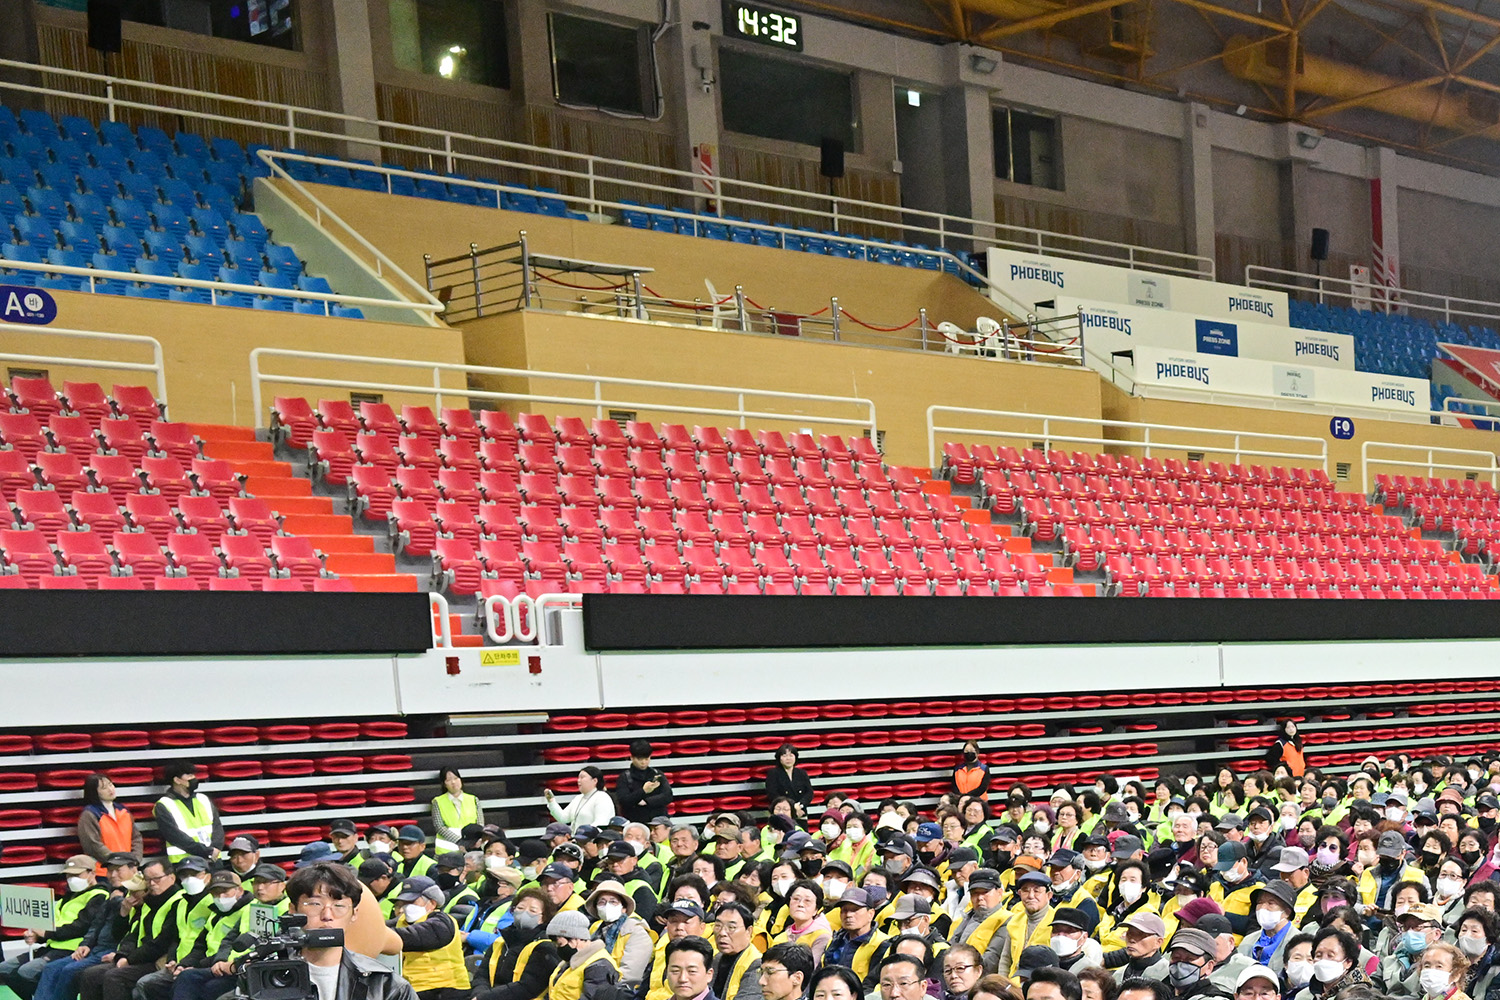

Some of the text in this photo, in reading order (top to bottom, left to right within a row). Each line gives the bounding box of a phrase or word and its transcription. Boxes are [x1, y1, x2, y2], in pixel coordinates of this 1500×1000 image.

[738, 7, 797, 45] 14:32
[1010, 264, 1064, 289] PHOEBUS
[5, 291, 25, 317] A
[1228, 296, 1274, 318] PHOEBUS
[1295, 340, 1340, 362] PHOEBUS
[1156, 362, 1210, 385] PHOEBUS
[1371, 386, 1416, 407] PHOEBUS
[5, 896, 50, 919] 시니어클럽
